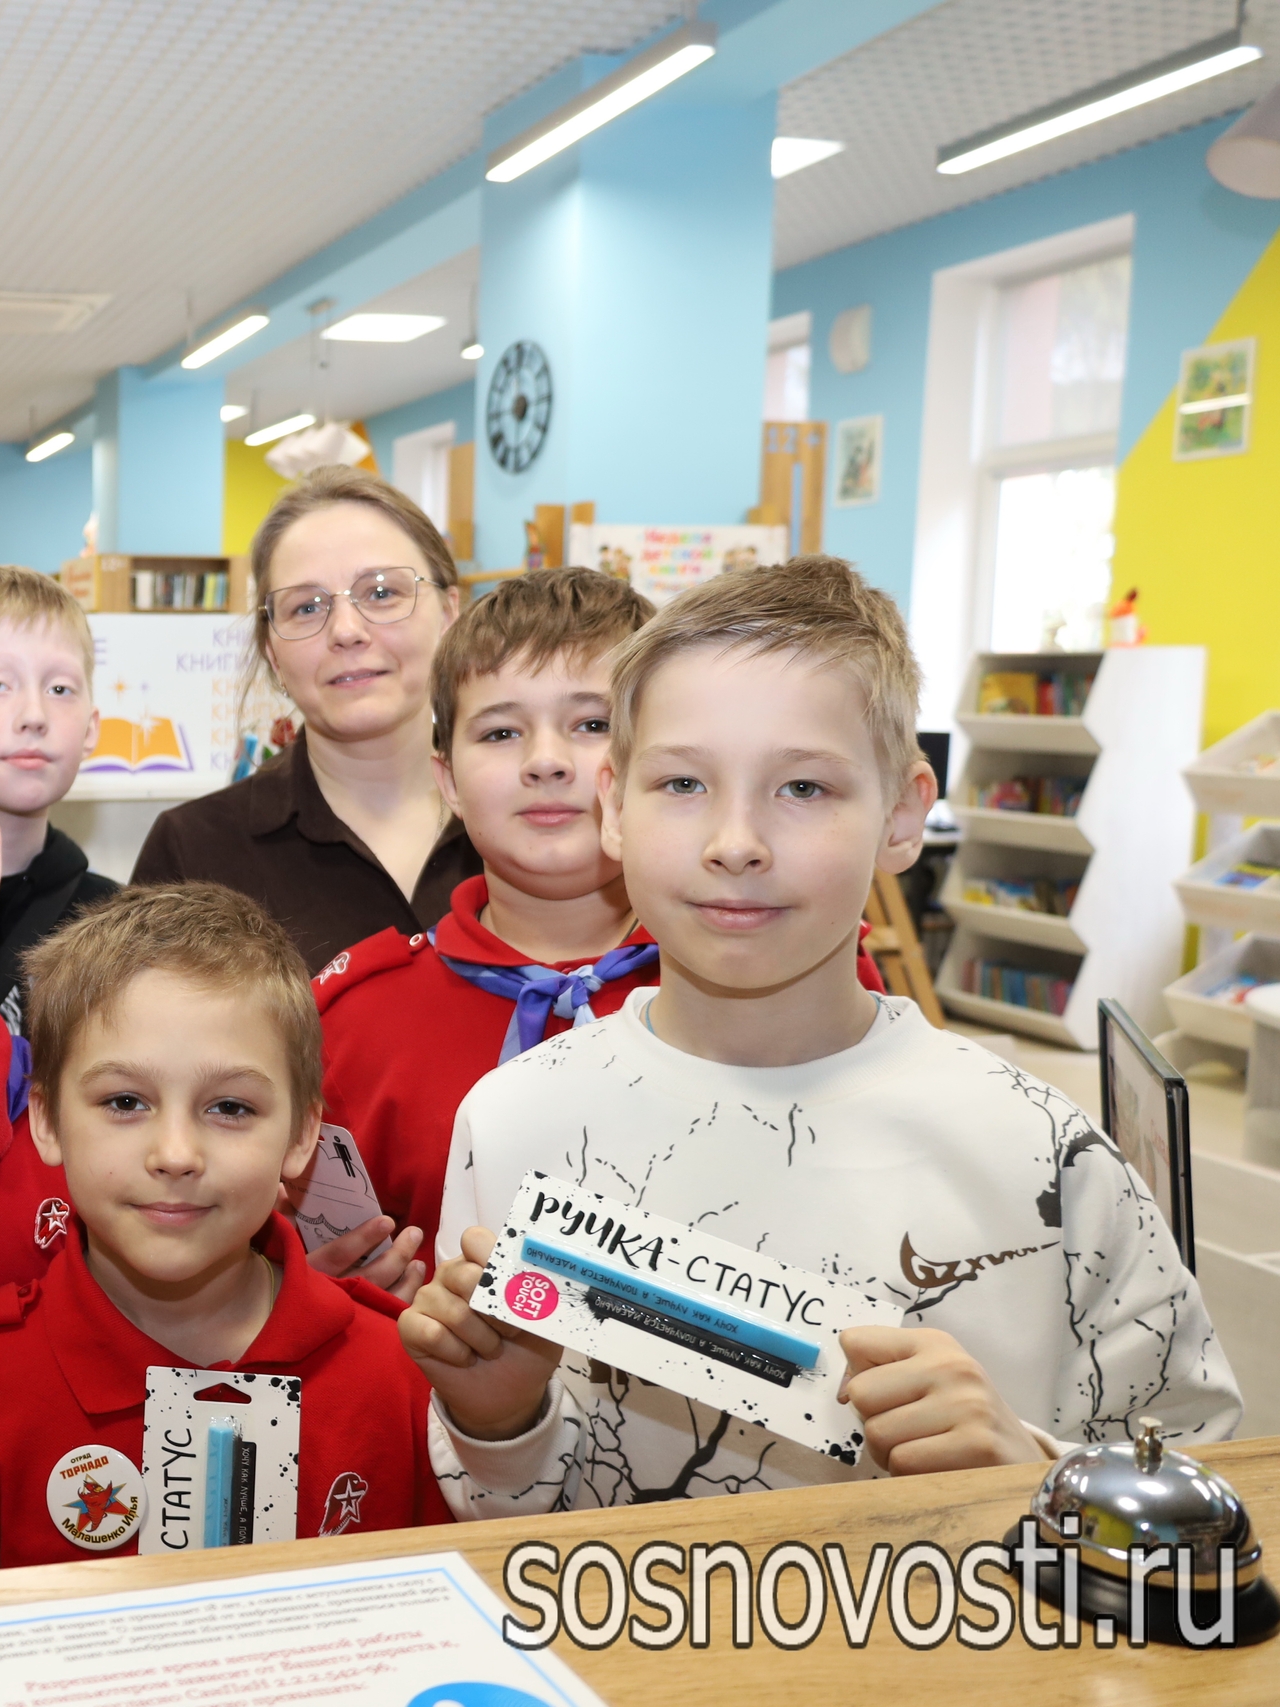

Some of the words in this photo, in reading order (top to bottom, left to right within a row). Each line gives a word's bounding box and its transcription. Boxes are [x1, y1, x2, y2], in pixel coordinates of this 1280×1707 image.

[526, 1246, 576, 1273] ИДЕАЛЬНО
[510, 1274, 534, 1313] TOUCH
[580, 1265, 638, 1298] ПОЛУЧАЕТСЯ
[642, 1288, 650, 1299] А
[529, 1276, 552, 1319] SOFT
[653, 1292, 689, 1316] ЛУЧШЕ,
[594, 1298, 640, 1323] ИДЕАЛЬНО
[692, 1306, 712, 1325] КАК
[643, 1315, 696, 1347] ПОЛУЧАЕТСЯ
[715, 1315, 739, 1335] ХОЧУ
[699, 1337, 707, 1348] А
[710, 1342, 740, 1365] ЛУЧШЕ,
[743, 1354, 763, 1373] КАК
[763, 1362, 787, 1381] ХОЧУ
[60, 1455, 109, 1480] ТОРНАДО
[70, 1453, 91, 1464] ОТРЯД
[240, 1447, 250, 1467] ХОЧУ
[241, 1469, 249, 1483] КАК
[160, 1427, 197, 1550] СТАТУС
[239, 1484, 248, 1515] ЛУЧШЕ,
[62, 1517, 126, 1544] Малашенко
[123, 1496, 138, 1527] Илья
